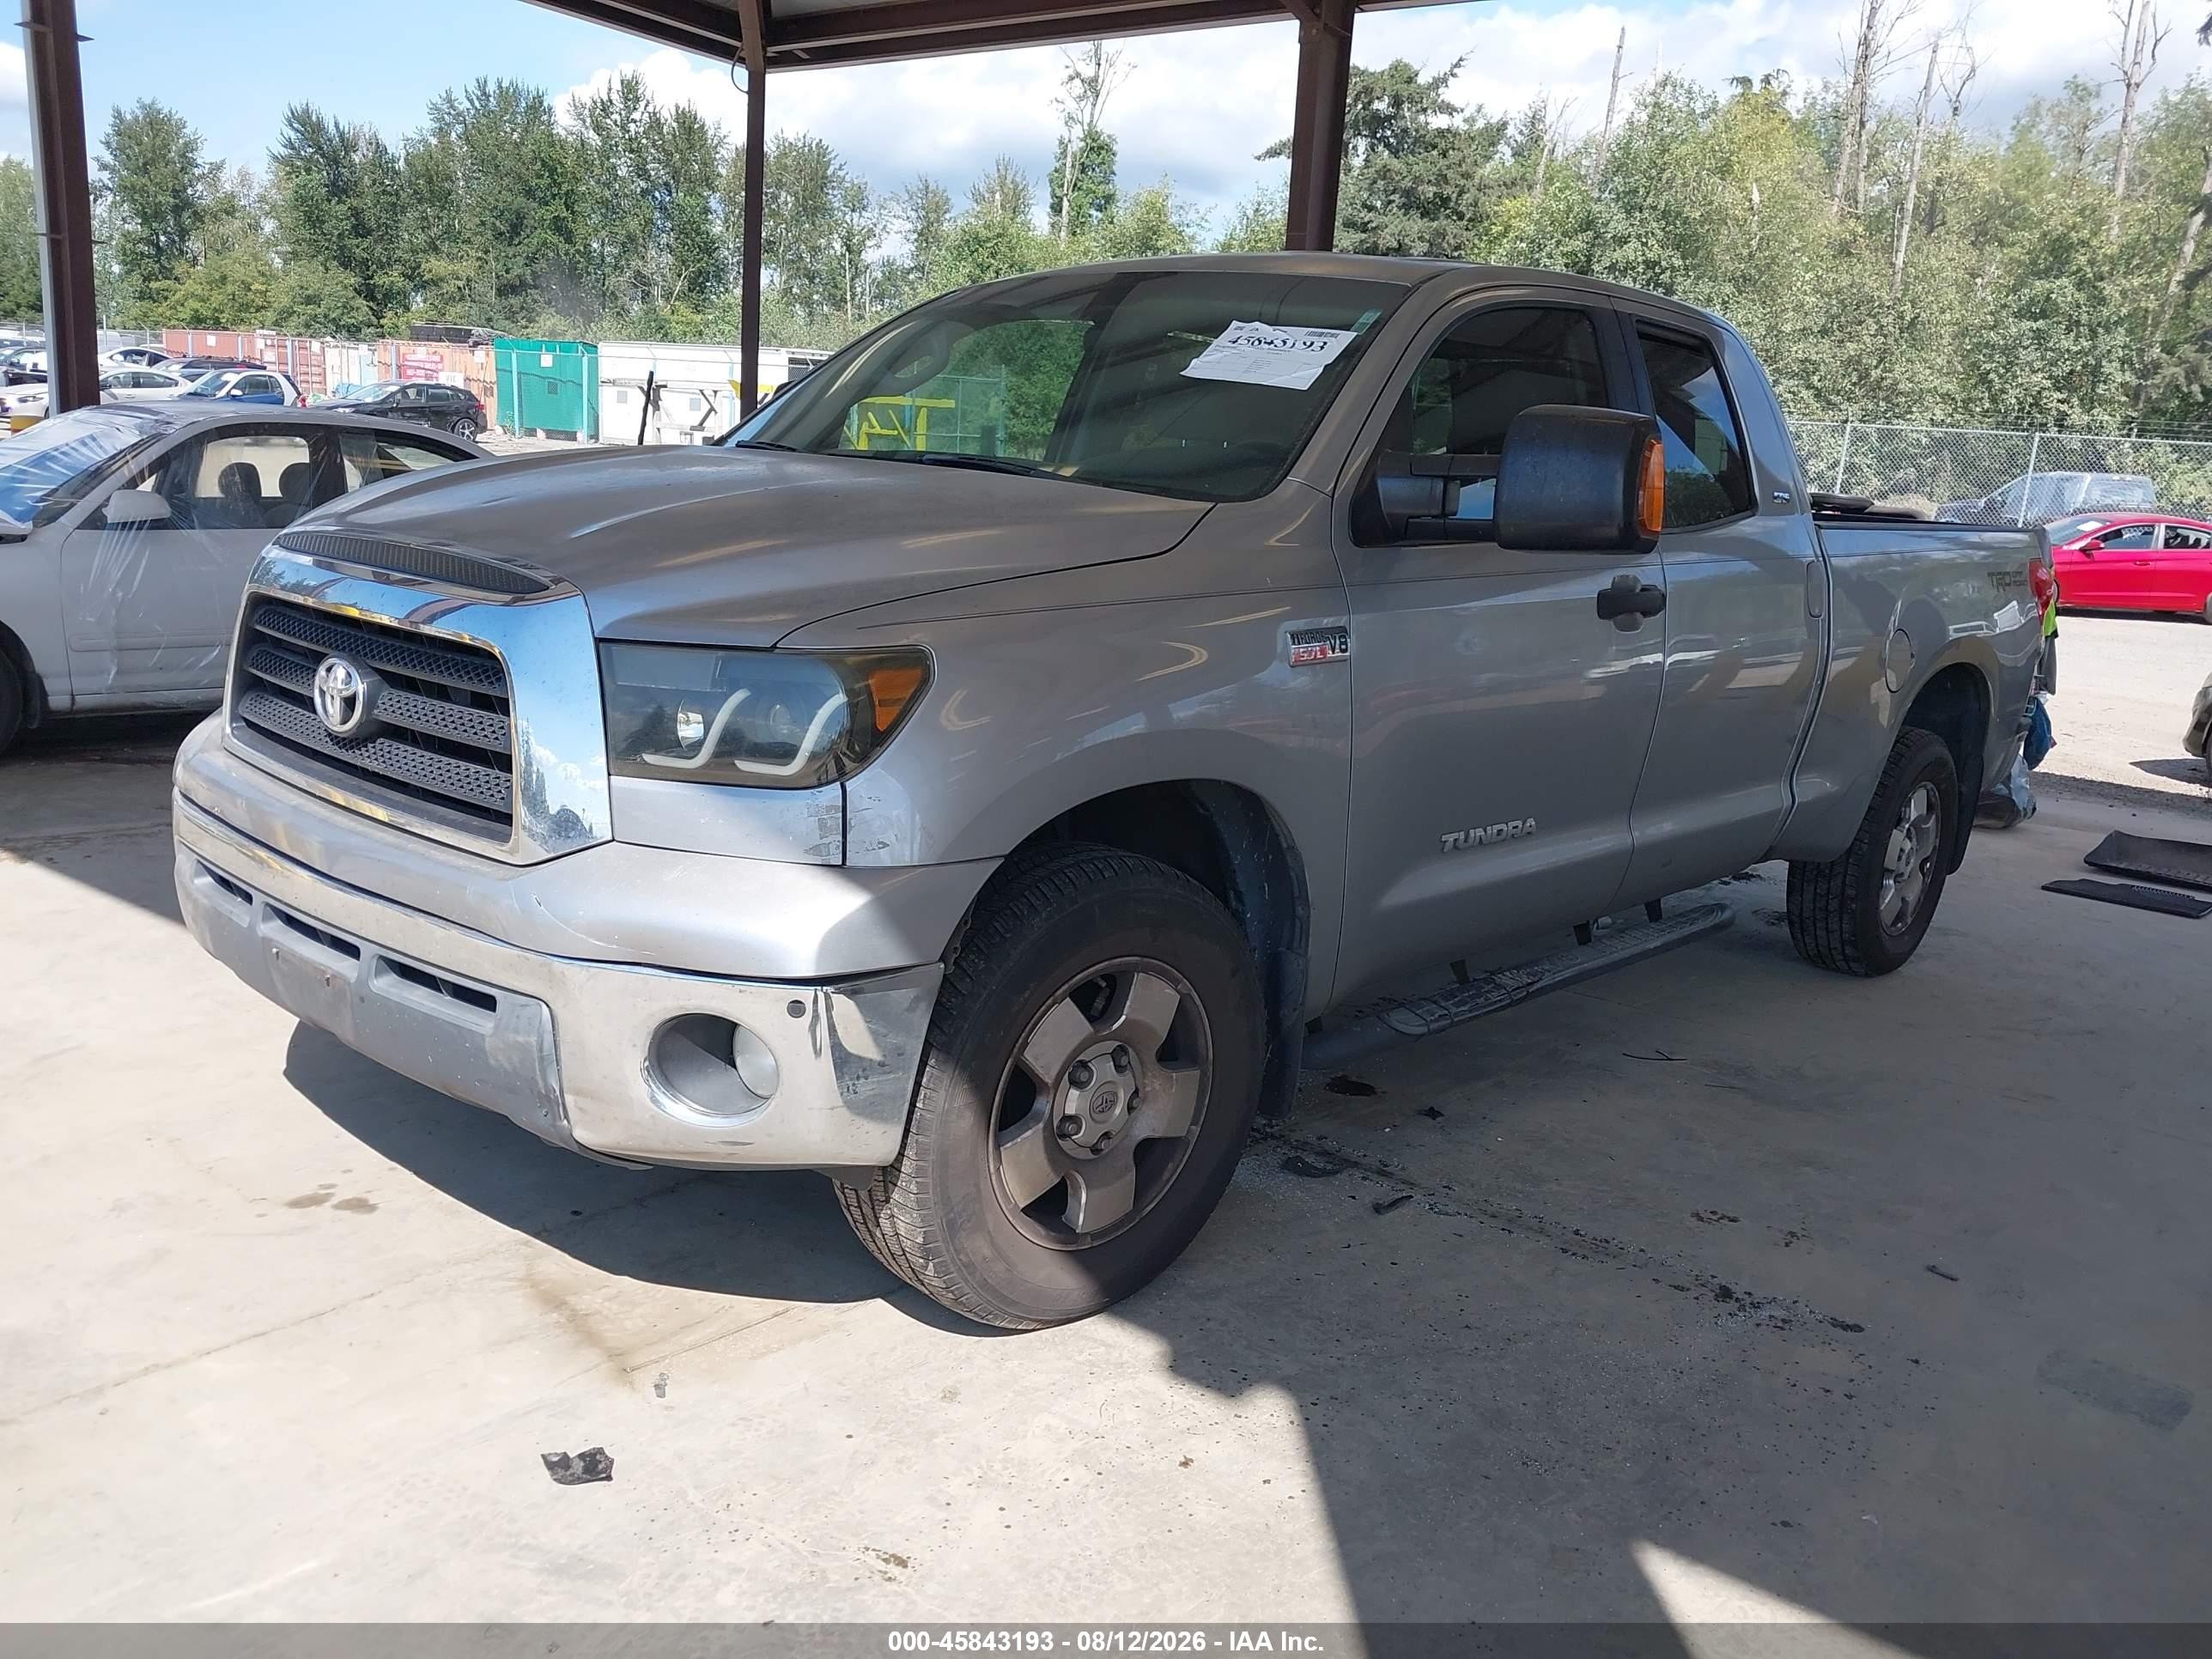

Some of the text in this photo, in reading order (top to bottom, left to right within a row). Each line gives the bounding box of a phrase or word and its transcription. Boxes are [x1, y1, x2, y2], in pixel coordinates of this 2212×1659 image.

[1987, 571, 2011, 592] TRD
[1328, 634, 1349, 654] V8
[1441, 817, 1537, 853] TUNDRA
